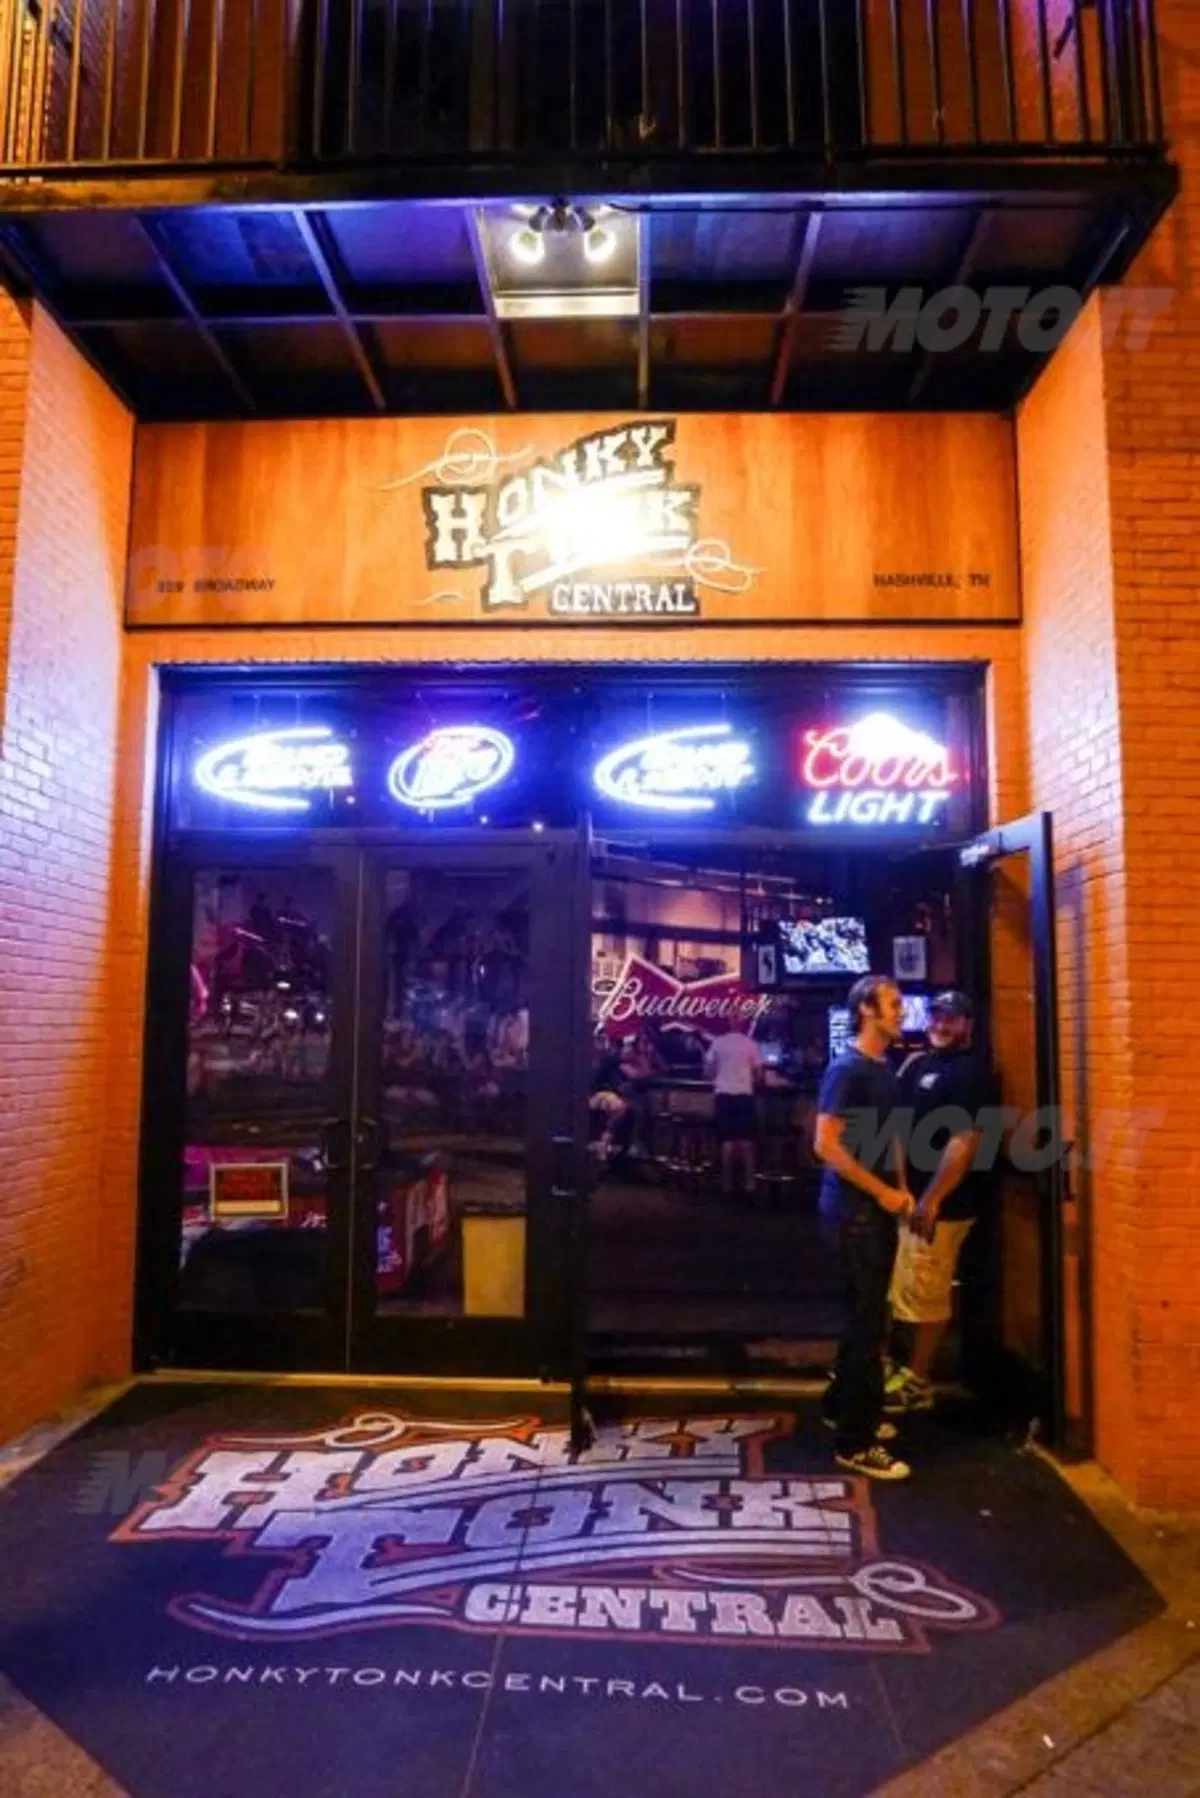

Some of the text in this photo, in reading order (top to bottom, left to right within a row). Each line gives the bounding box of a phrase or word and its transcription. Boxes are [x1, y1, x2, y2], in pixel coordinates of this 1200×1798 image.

[430, 425, 667, 562] HONKY
[551, 582, 695, 612] CENTRAL
[804, 728, 956, 787] Coors
[806, 790, 949, 823] LIGHT
[138, 1419, 778, 1530] HONKY
[253, 1480, 851, 1610] TONK
[464, 1583, 903, 1640] CENTRAL
[146, 1665, 848, 1708] HONKYTONKCENTRAL.COM
